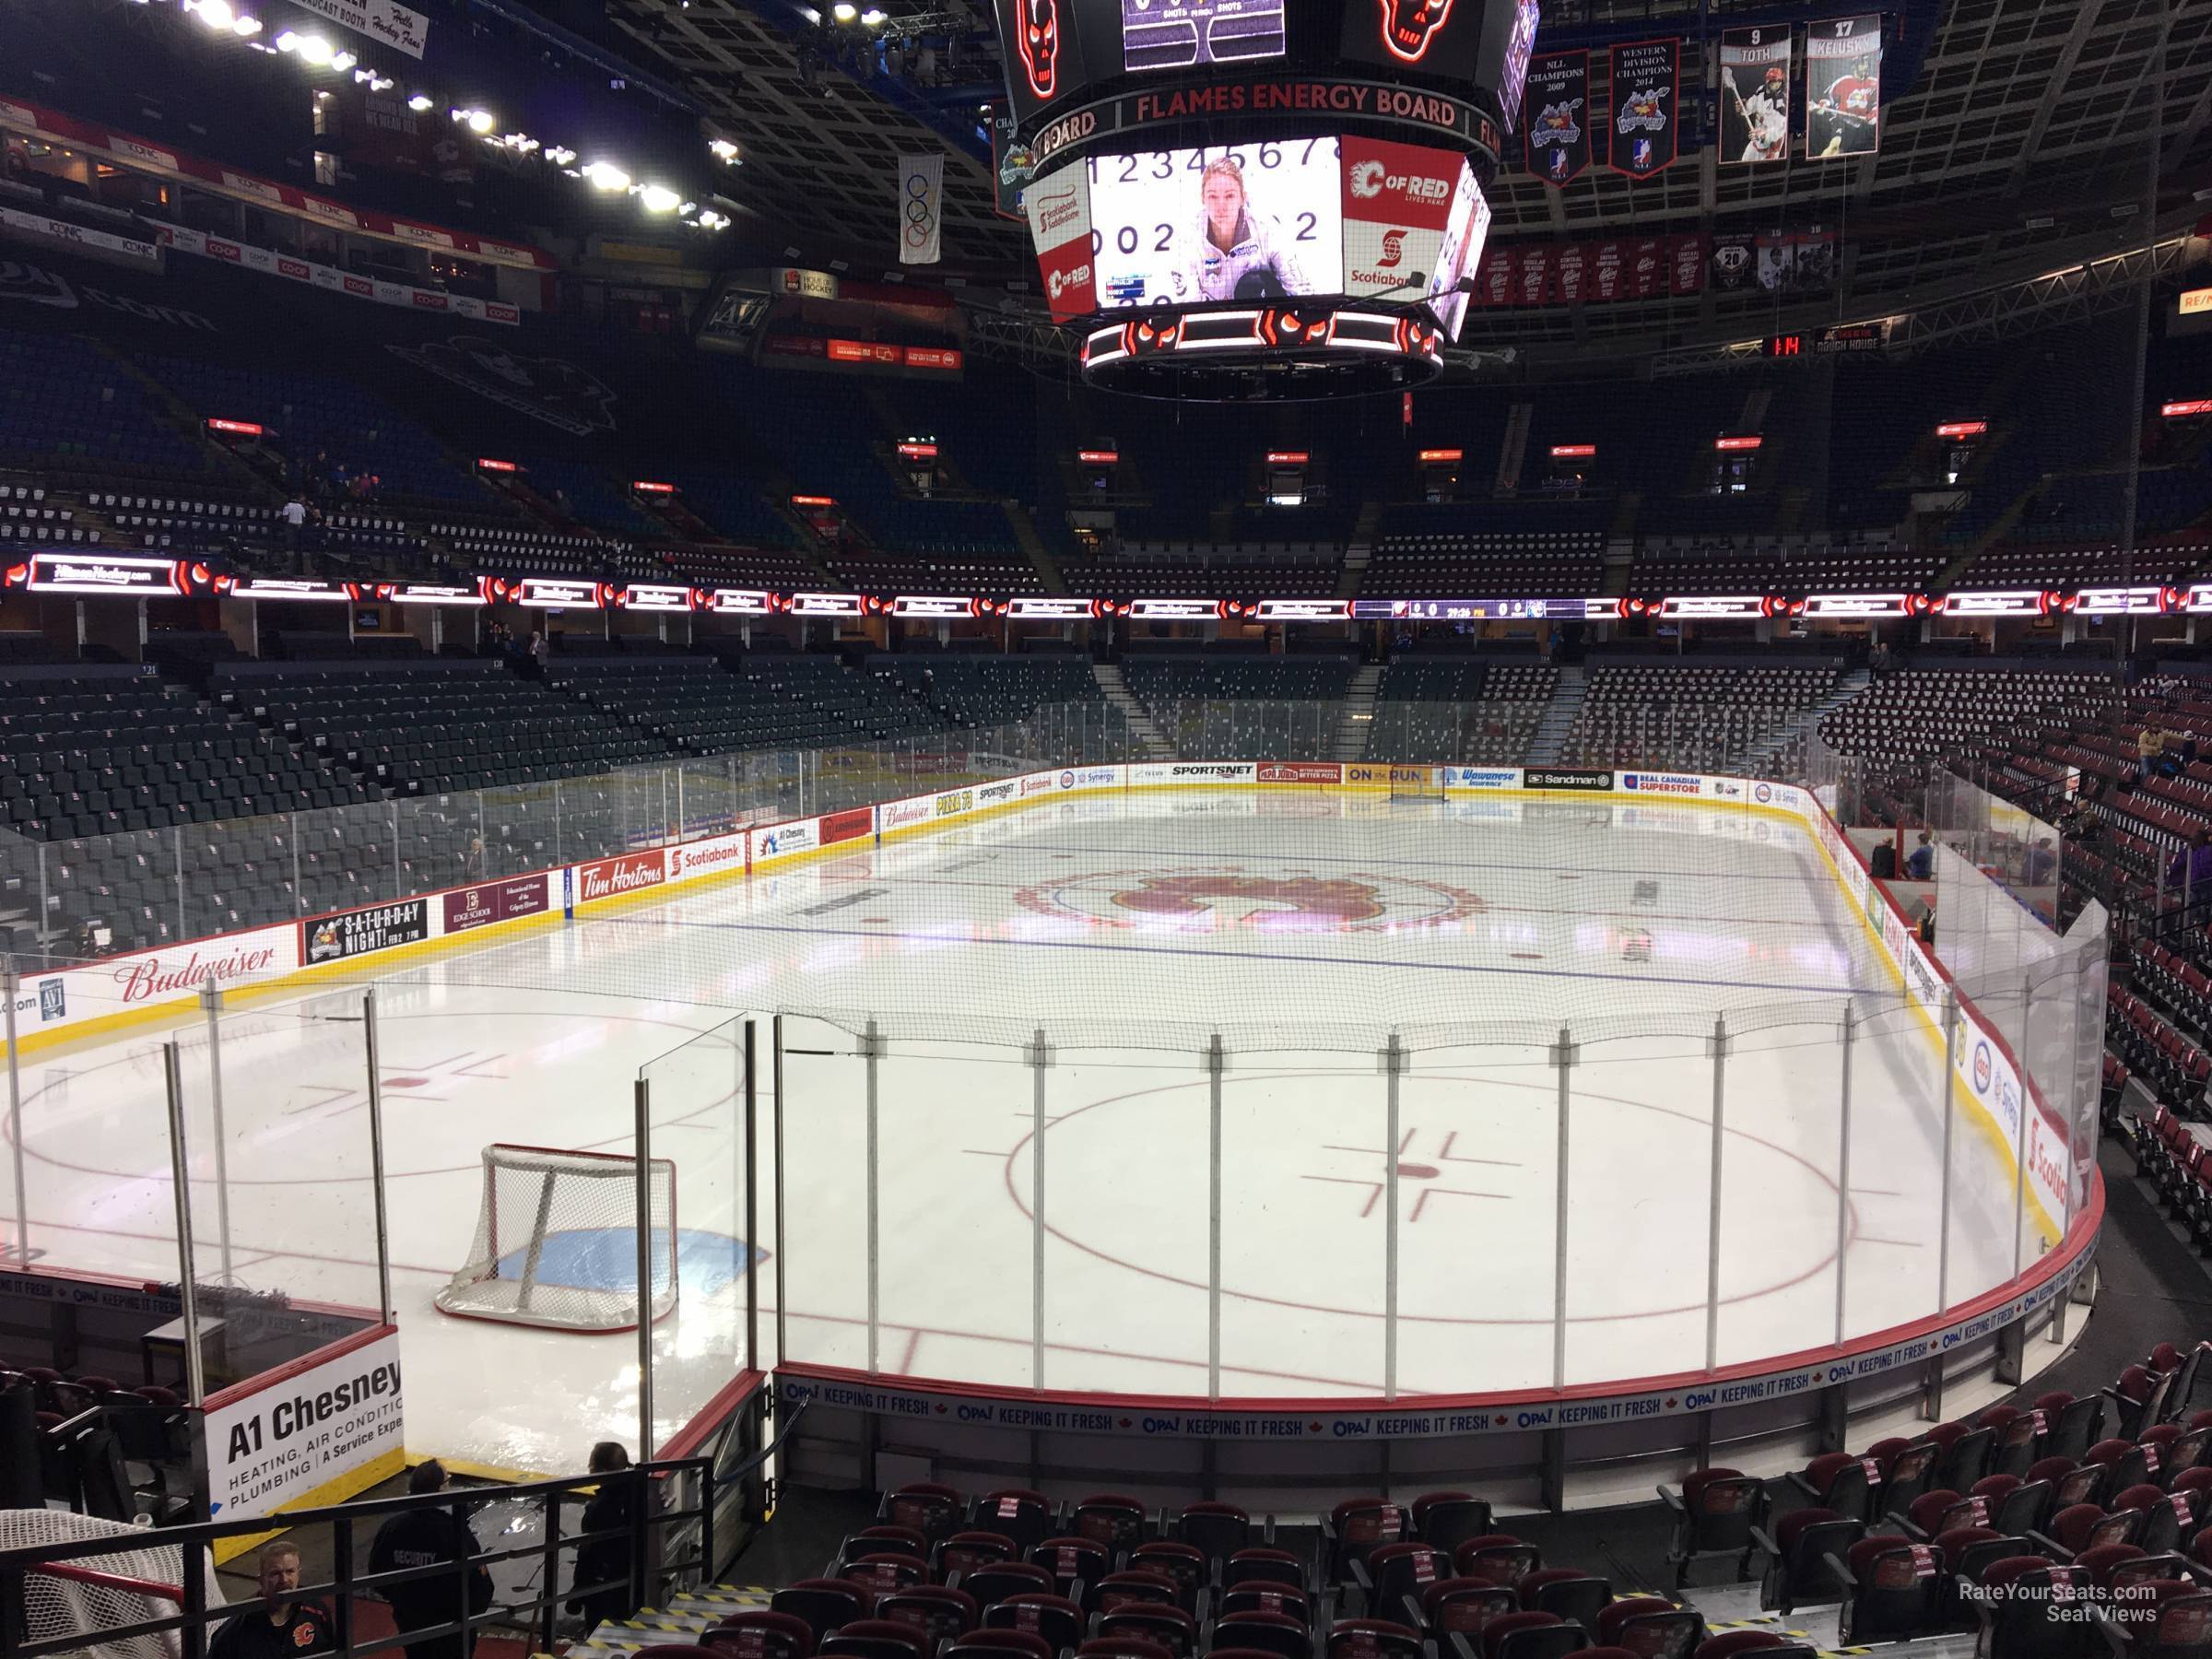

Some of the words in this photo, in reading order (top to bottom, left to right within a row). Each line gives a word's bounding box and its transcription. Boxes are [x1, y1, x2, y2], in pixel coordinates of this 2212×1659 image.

[1163, 7, 1188, 18] SHOTS
[1217, 3, 1242, 13] SHOTS
[339, 8, 366, 30] BOOTH
[372, 16, 400, 41] Hockey
[1835, 21, 1853, 37] 17
[1751, 29, 1760, 45] 9
[1622, 46, 1667, 57] WESTERN
[1817, 37, 1870, 54] KELUSKY
[1623, 56, 1665, 68] DIVISION
[1741, 49, 1771, 62] TOTH
[1528, 68, 1584, 84] CHAMPIONS
[1617, 65, 1673, 79] CHAMPIONS
[1547, 82, 1566, 92] 2009
[1635, 77, 1653, 88] 2014
[1136, 84, 1244, 122] FLAMES
[1253, 83, 1368, 111] ENERGY
[1376, 88, 1456, 127] BOARD
[1043, 112, 1097, 155] BOARD
[1118, 155, 1139, 182] 2
[1151, 152, 1173, 179] 3
[1386, 176, 1407, 190] OF
[1407, 174, 1449, 198] RED
[1406, 195, 1425, 204] LIVES
[1046, 197, 1077, 219] Scotiabank
[1048, 209, 1079, 229] Saddledome
[1296, 212, 1317, 241] 2
[1154, 223, 1174, 252] 2
[122, 240, 154, 256] ICONIC
[1725, 253, 1739, 265] 20
[1062, 276, 1072, 286] OF
[1073, 265, 1089, 282] RED
[804, 284, 832, 294] HOCKEY
[417, 295, 445, 307] CO-OP
[489, 310, 516, 321] CO-OP
[1849, 338, 1877, 349] HOUSE
[1088, 773, 1114, 782] Synergy
[1172, 766, 1253, 775] SPORTSNET
[1349, 769, 1371, 781] ON
[1389, 770, 1420, 782] RUN
[1462, 770, 1516, 780] Wawanesa
[1545, 775, 1596, 784] Sandman
[1661, 776, 1700, 784] CANADIAN
[980, 783, 1014, 799] SPORTSNET
[1640, 783, 1700, 794] SUPERSTORE
[936, 795, 960, 816] PIZZA
[686, 846, 738, 867] Scotiabank
[583, 867, 608, 897] Tim
[611, 863, 662, 893] Hortons
[453, 914, 468, 923] EDGE
[345, 929, 386, 955] NIGHT!
[114, 947, 274, 1003] Budweiser
[1829, 1360, 1855, 1382] OPA!
[1858, 1349, 1890, 1373] KEEPING
[1893, 1346, 1901, 1364] IT
[1903, 1340, 1927, 1359] FRESH
[786, 1383, 819, 1399] OPA!
[824, 1388, 873, 1407] KEEPING
[877, 1394, 888, 1409] IT
[890, 1397, 929, 1415] FRESH
[1686, 1394, 1717, 1410] OPA!
[1721, 1385, 1762, 1404] KEEPING
[1765, 1382, 1777, 1397] IT
[1779, 1374, 1809, 1392] FRESH
[228, 1415, 262, 1465] A1
[273, 1359, 400, 1441] Chesney
[957, 1406, 993, 1422] OPA!
[998, 1407, 1053, 1427] KEEPING
[1055, 1412, 1068, 1428] IT
[1071, 1413, 1112, 1430] FRESH
[1517, 1408, 1554, 1428] OPA!
[1559, 1406, 1608, 1423] KEEPING
[1611, 1404, 1623, 1419] IT
[1625, 1398, 1660, 1415] FRESH
[1142, 1417, 1180, 1433] OPA!
[1185, 1418, 1241, 1435] KEEPING
[1245, 1418, 1257, 1434] IT
[1261, 1418, 1302, 1435] FRESH
[1333, 1418, 1371, 1437] OPA!
[1376, 1417, 1430, 1434] KEEPING
[1433, 1417, 1445, 1433] IT
[1450, 1415, 1489, 1431] FRESH
[229, 1449, 301, 1491] HEATING,
[306, 1432, 330, 1453] AIR
[229, 1462, 311, 1510] PLUMBING
[323, 1450, 330, 1465] A
[334, 1429, 374, 1459] Service
